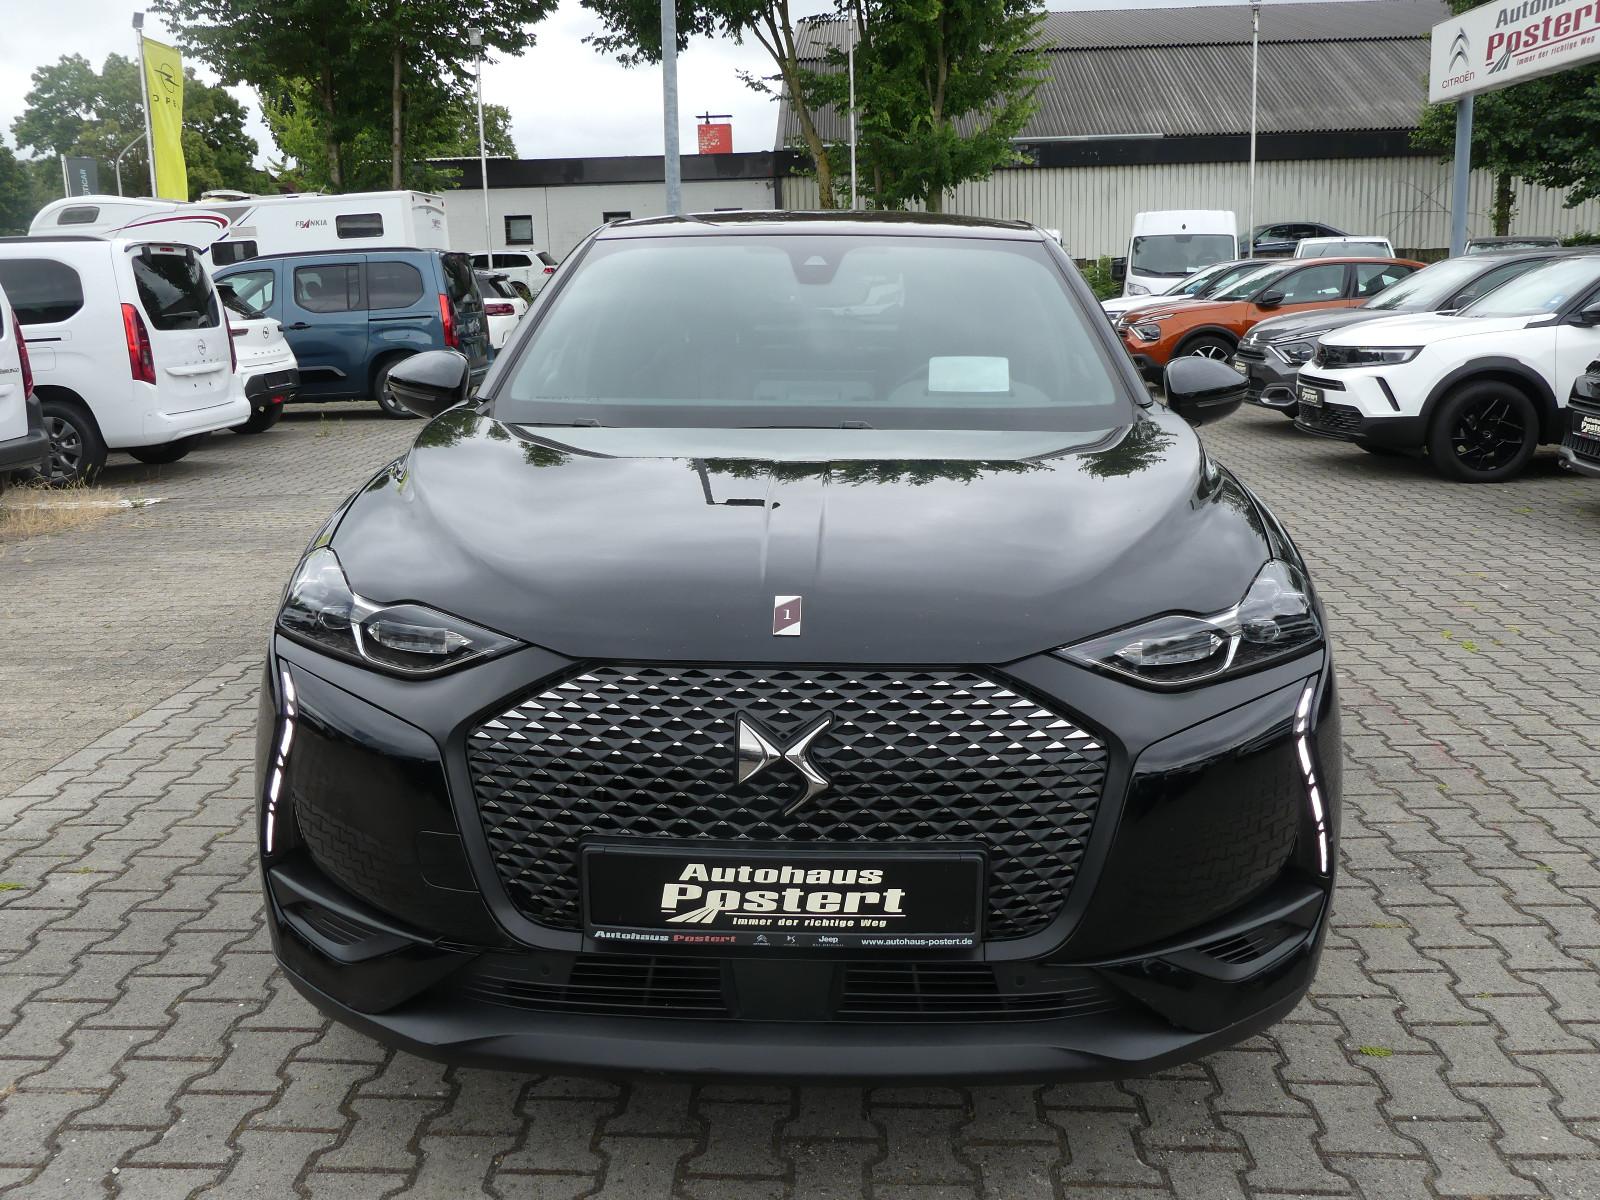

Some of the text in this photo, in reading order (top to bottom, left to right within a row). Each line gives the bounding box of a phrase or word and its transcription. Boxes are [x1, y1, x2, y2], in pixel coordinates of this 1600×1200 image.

[295, 219, 328, 229] FRANKIA
[678, 863, 884, 884] Autohaus
[660, 883, 906, 914] Postert
[777, 918, 799, 926] der
[804, 918, 855, 928] richtige
[860, 919, 887, 928] Weg
[594, 930, 737, 943] Autohaus Postert
[818, 935, 839, 944] Jeep
[861, 937, 973, 947] www.autohaus-postert.de
